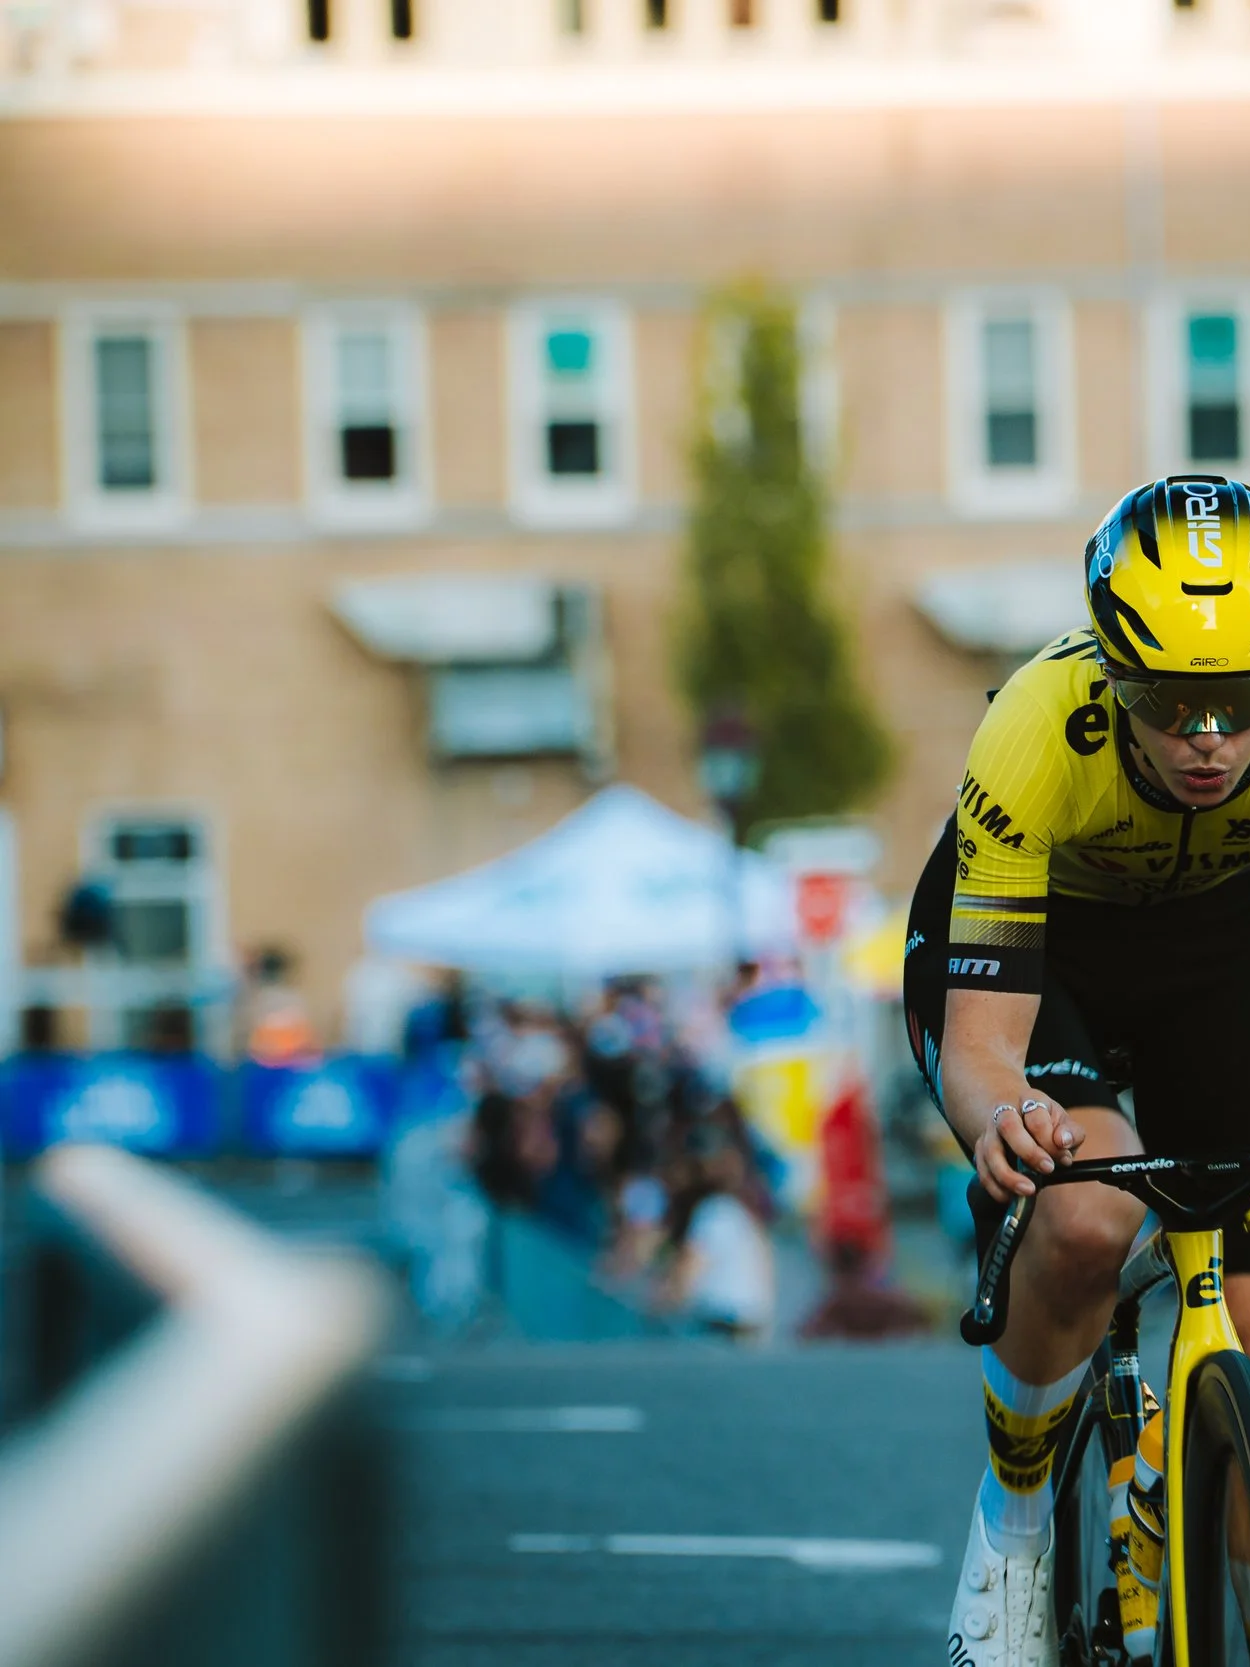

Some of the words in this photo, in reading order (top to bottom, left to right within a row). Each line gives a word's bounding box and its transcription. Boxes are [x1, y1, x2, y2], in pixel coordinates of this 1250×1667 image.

[960, 769, 1025, 849] VISMA
[1111, 1157, 1176, 1174] cervélo
[1207, 1161, 1241, 1171] GARMIN
